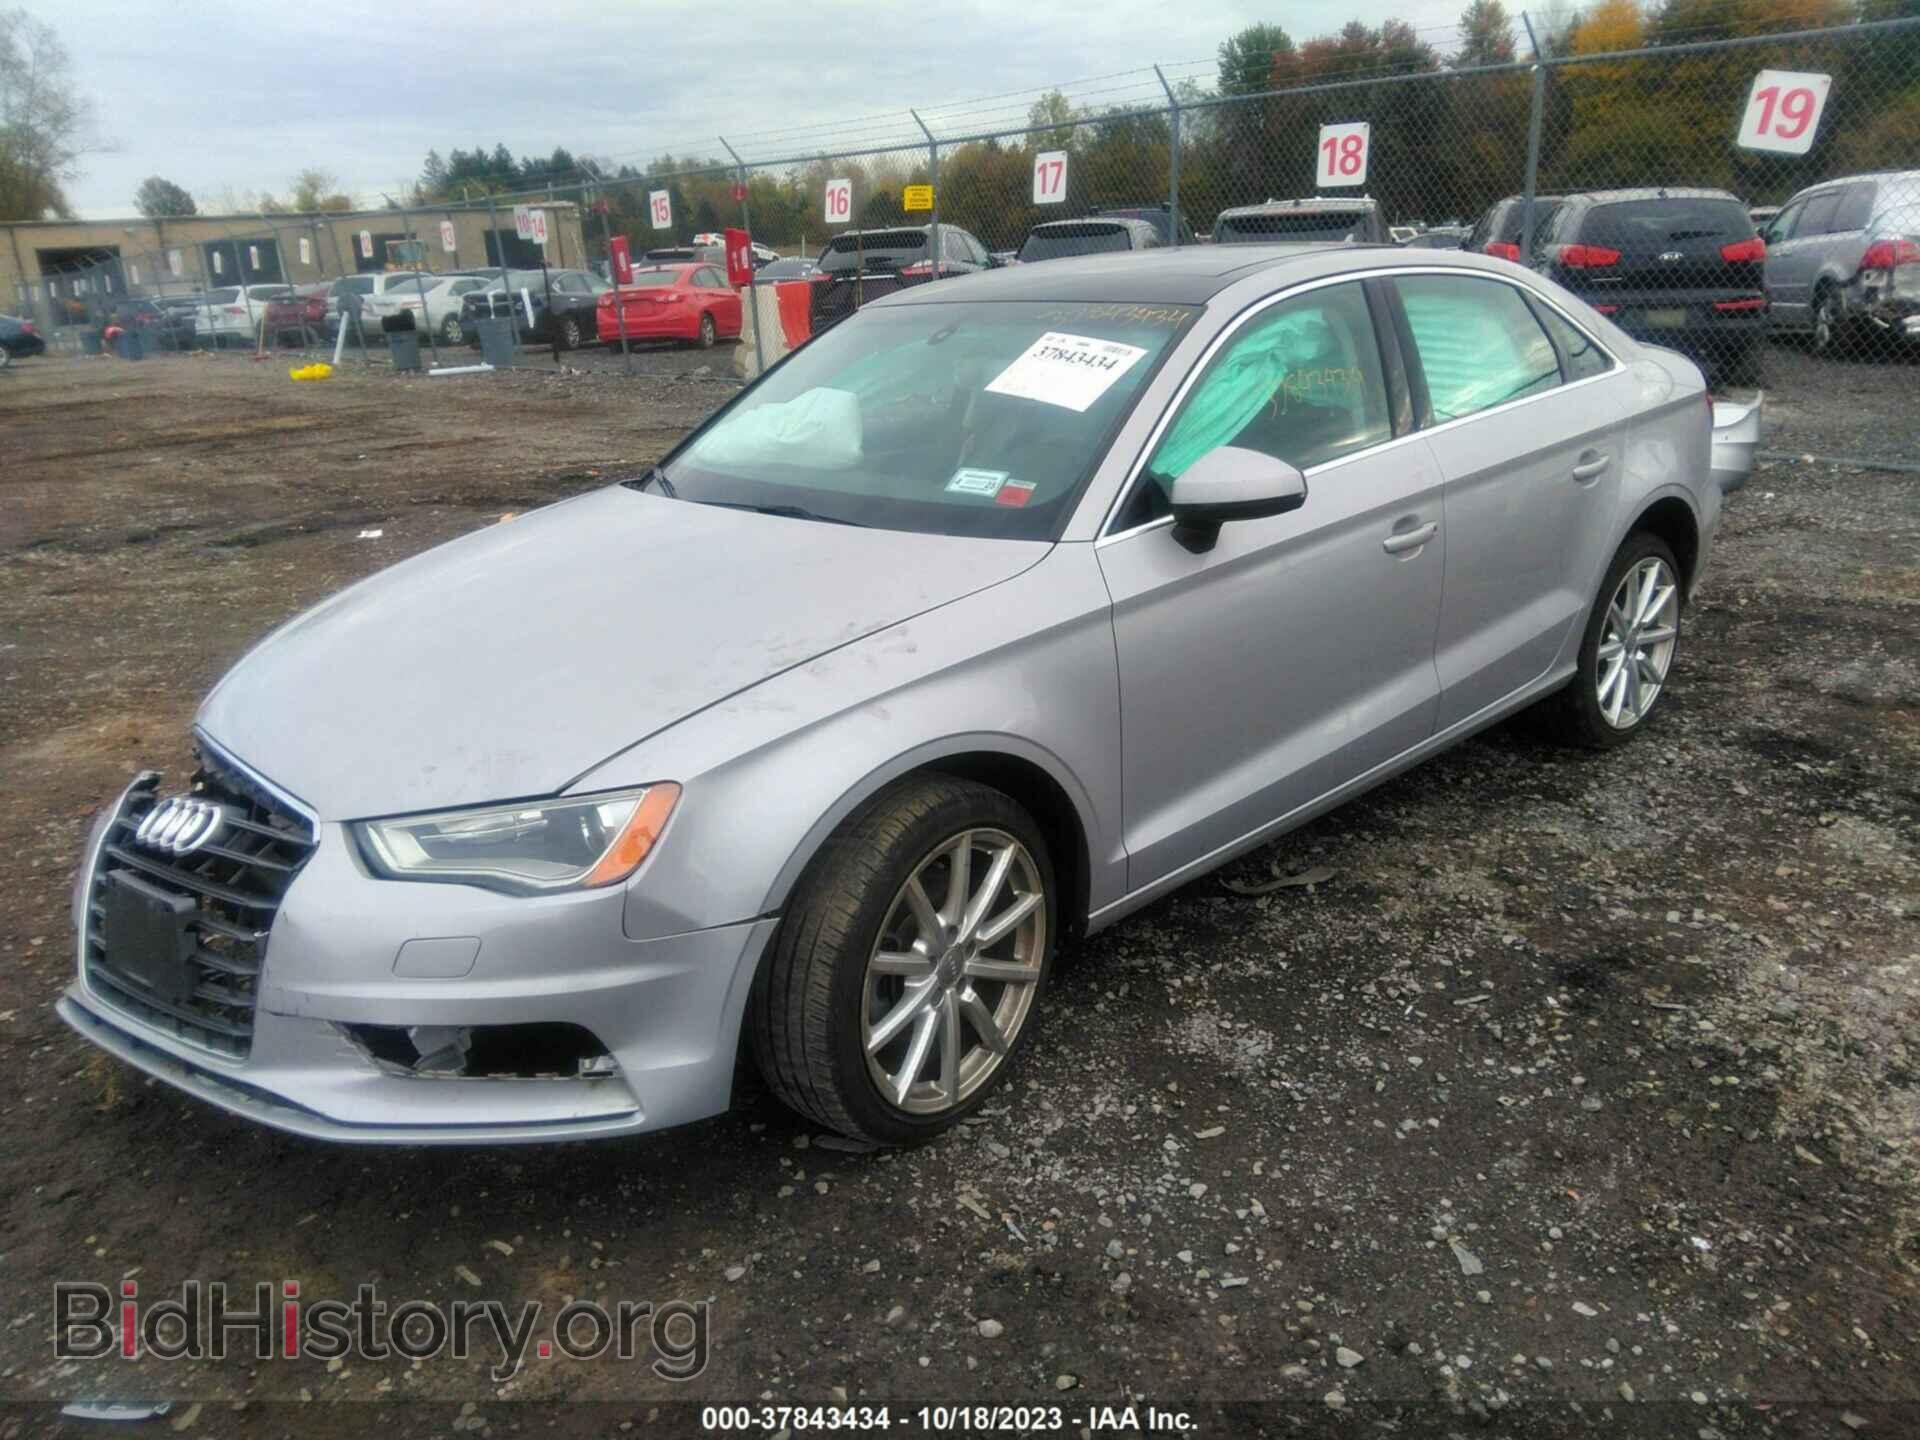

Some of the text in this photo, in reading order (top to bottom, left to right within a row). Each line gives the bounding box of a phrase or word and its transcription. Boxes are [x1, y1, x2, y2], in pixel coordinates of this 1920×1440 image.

[1755, 85, 1816, 139] 19
[1322, 134, 1363, 177] 18
[1037, 161, 1063, 195] 17
[652, 198, 669, 223] 15
[827, 187, 849, 215] 16
[531, 217, 545, 237] 14
[1032, 345, 1119, 371] 37843434
